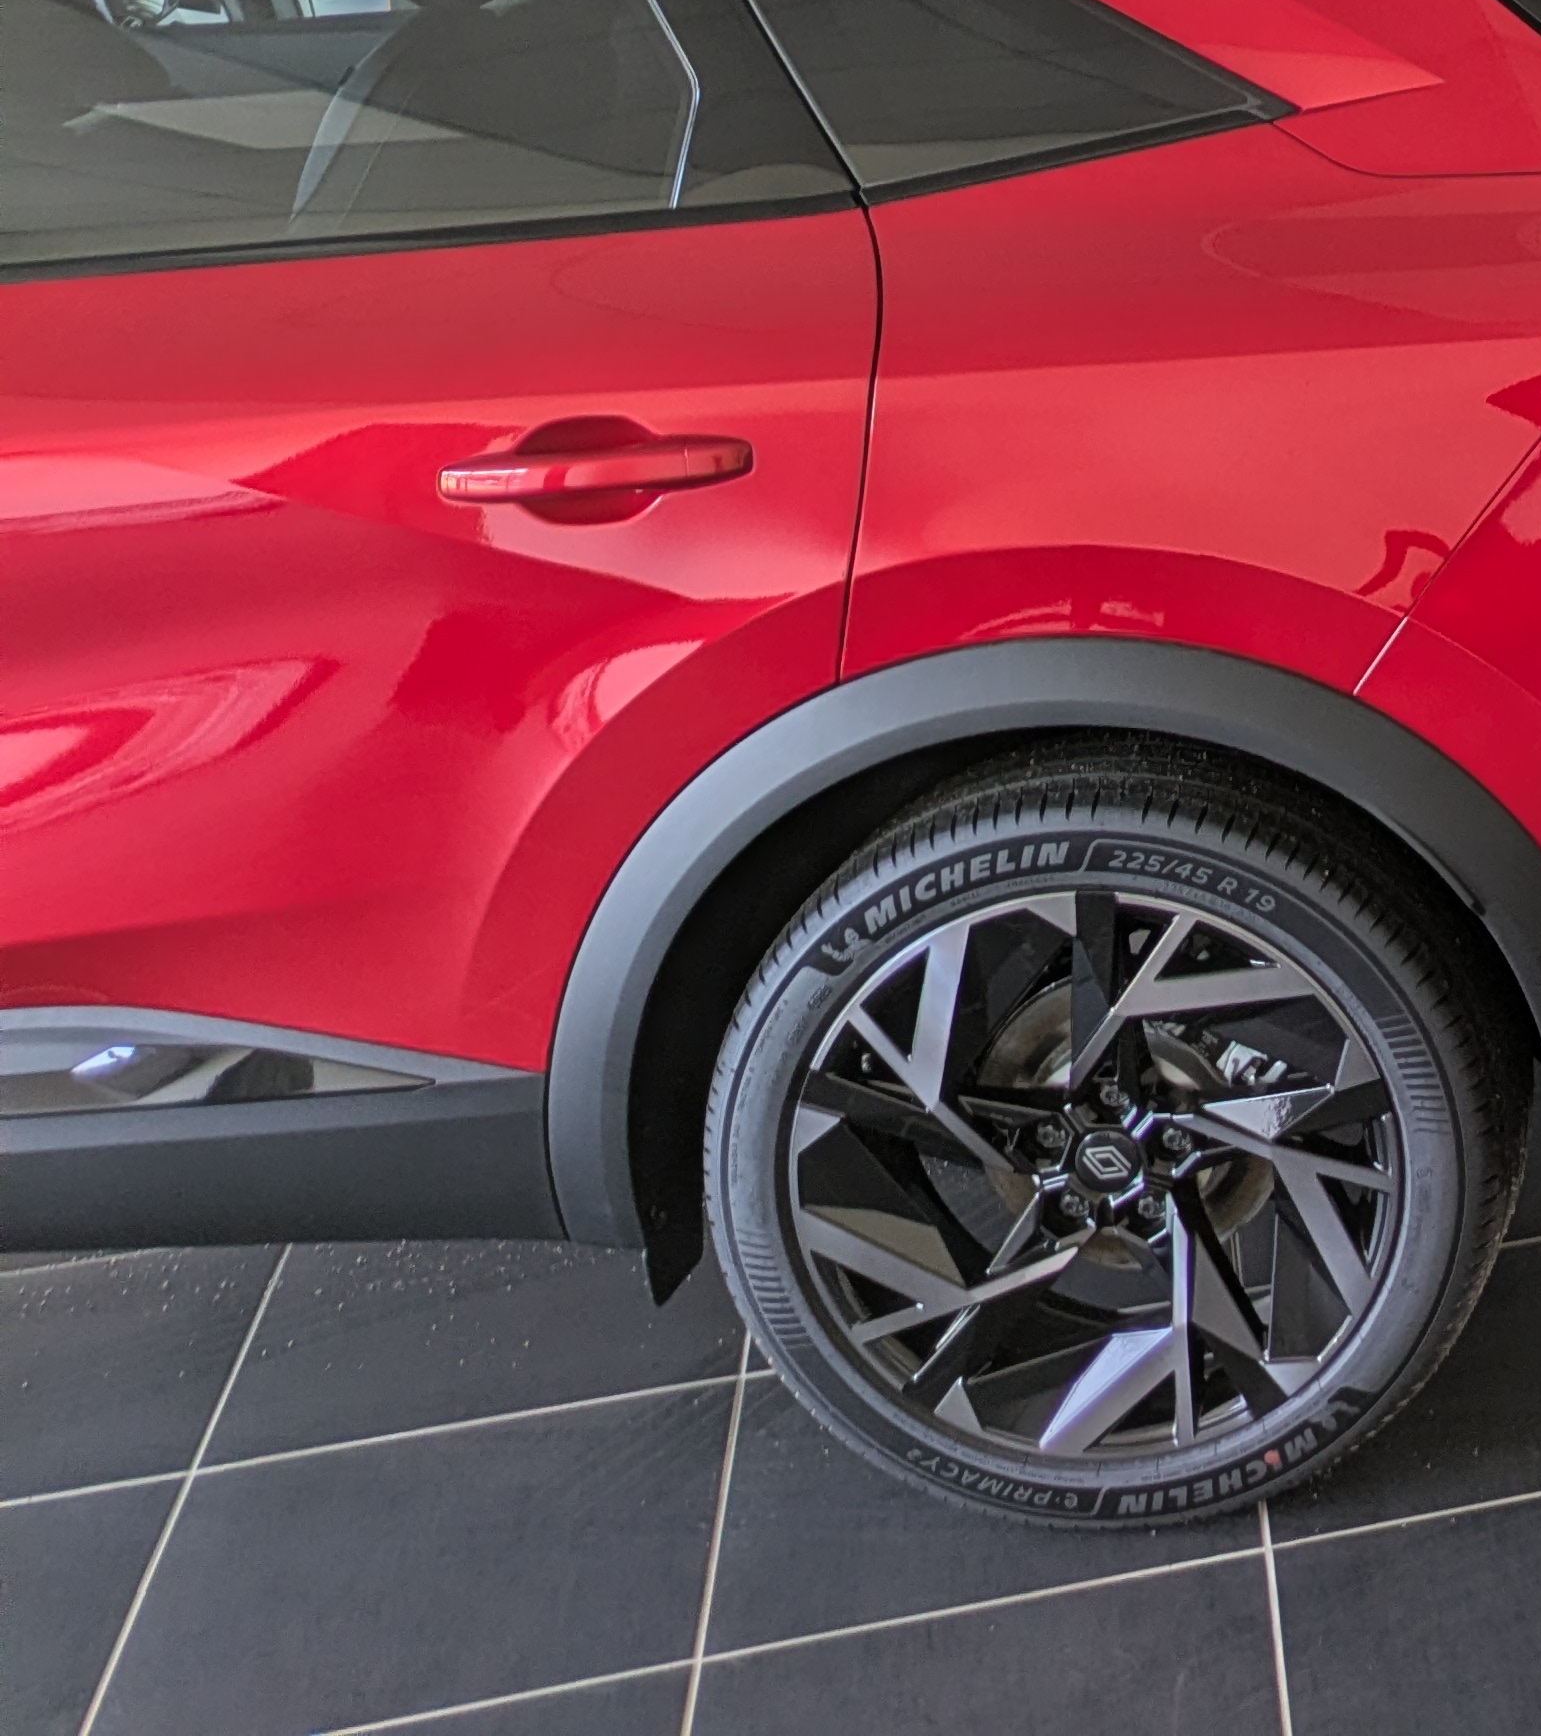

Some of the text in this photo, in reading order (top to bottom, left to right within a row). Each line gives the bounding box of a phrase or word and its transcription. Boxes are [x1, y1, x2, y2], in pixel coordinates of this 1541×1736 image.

[863, 841, 1070, 935] MICHELIN
[1108, 850, 1213, 885] 225/45
[1216, 876, 1238, 895] R
[1244, 888, 1276, 913] 19
[1117, 1426, 1320, 1516] MICHELIN
